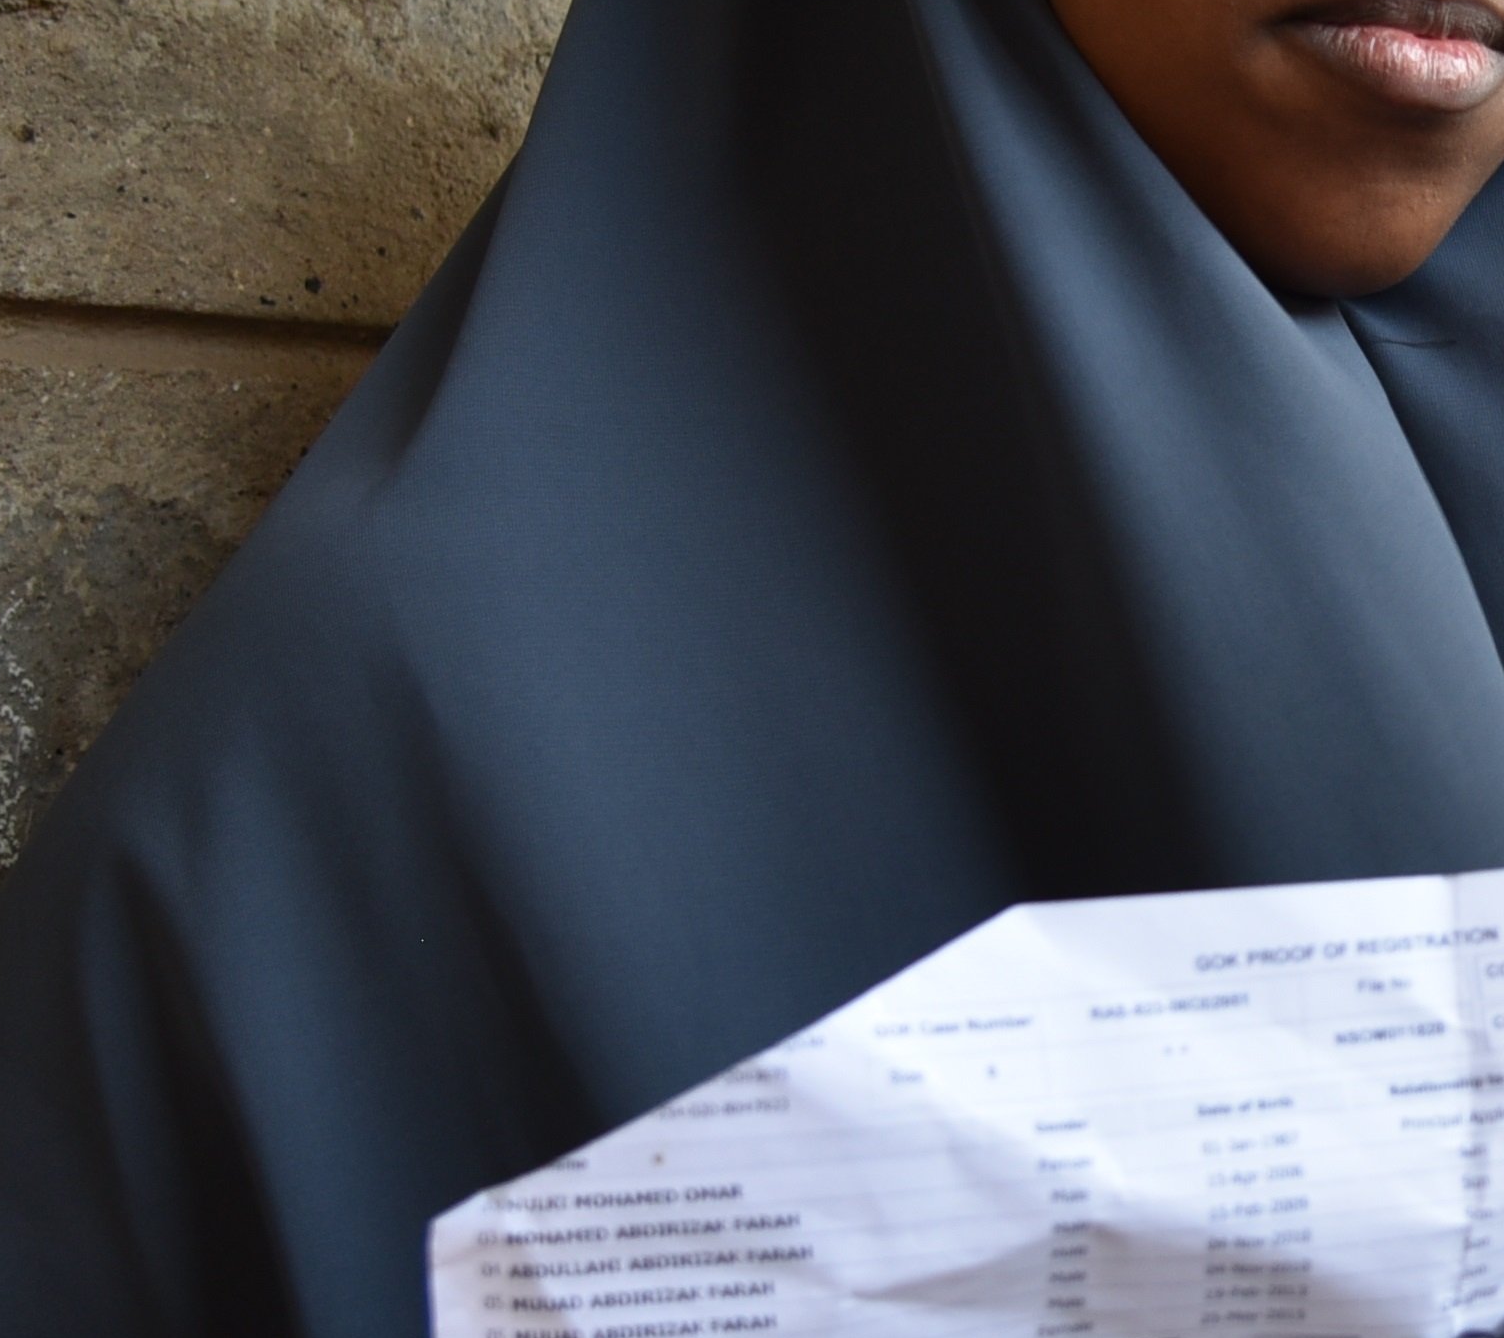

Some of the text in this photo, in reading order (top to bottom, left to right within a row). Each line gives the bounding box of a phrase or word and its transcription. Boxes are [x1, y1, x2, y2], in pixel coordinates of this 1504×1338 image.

[1196, 926, 1499, 972] GOK PROOF OF REGISTRATION
[967, 1015, 1032, 1032] Number
[1389, 1072, 1482, 1097] Relationship
[1197, 1094, 1294, 1118] Date of Birth
[1401, 1112, 1462, 1131] Principal
[574, 1185, 680, 1211] MOHAMED
[683, 1182, 745, 1203] OMAR
[505, 1226, 610, 1248] MOHAMED
[615, 1216, 726, 1241] ABDIRIZAK
[731, 1212, 802, 1234] FARAH
[507, 1257, 622, 1281] ABDULLAHI
[627, 1248, 741, 1273] ABDIRIZAK
[745, 1244, 815, 1265] FARAH
[590, 1284, 703, 1311] ABDIRIZAK
[707, 1279, 777, 1301] FARAH
[709, 1313, 779, 1335] FARAH
